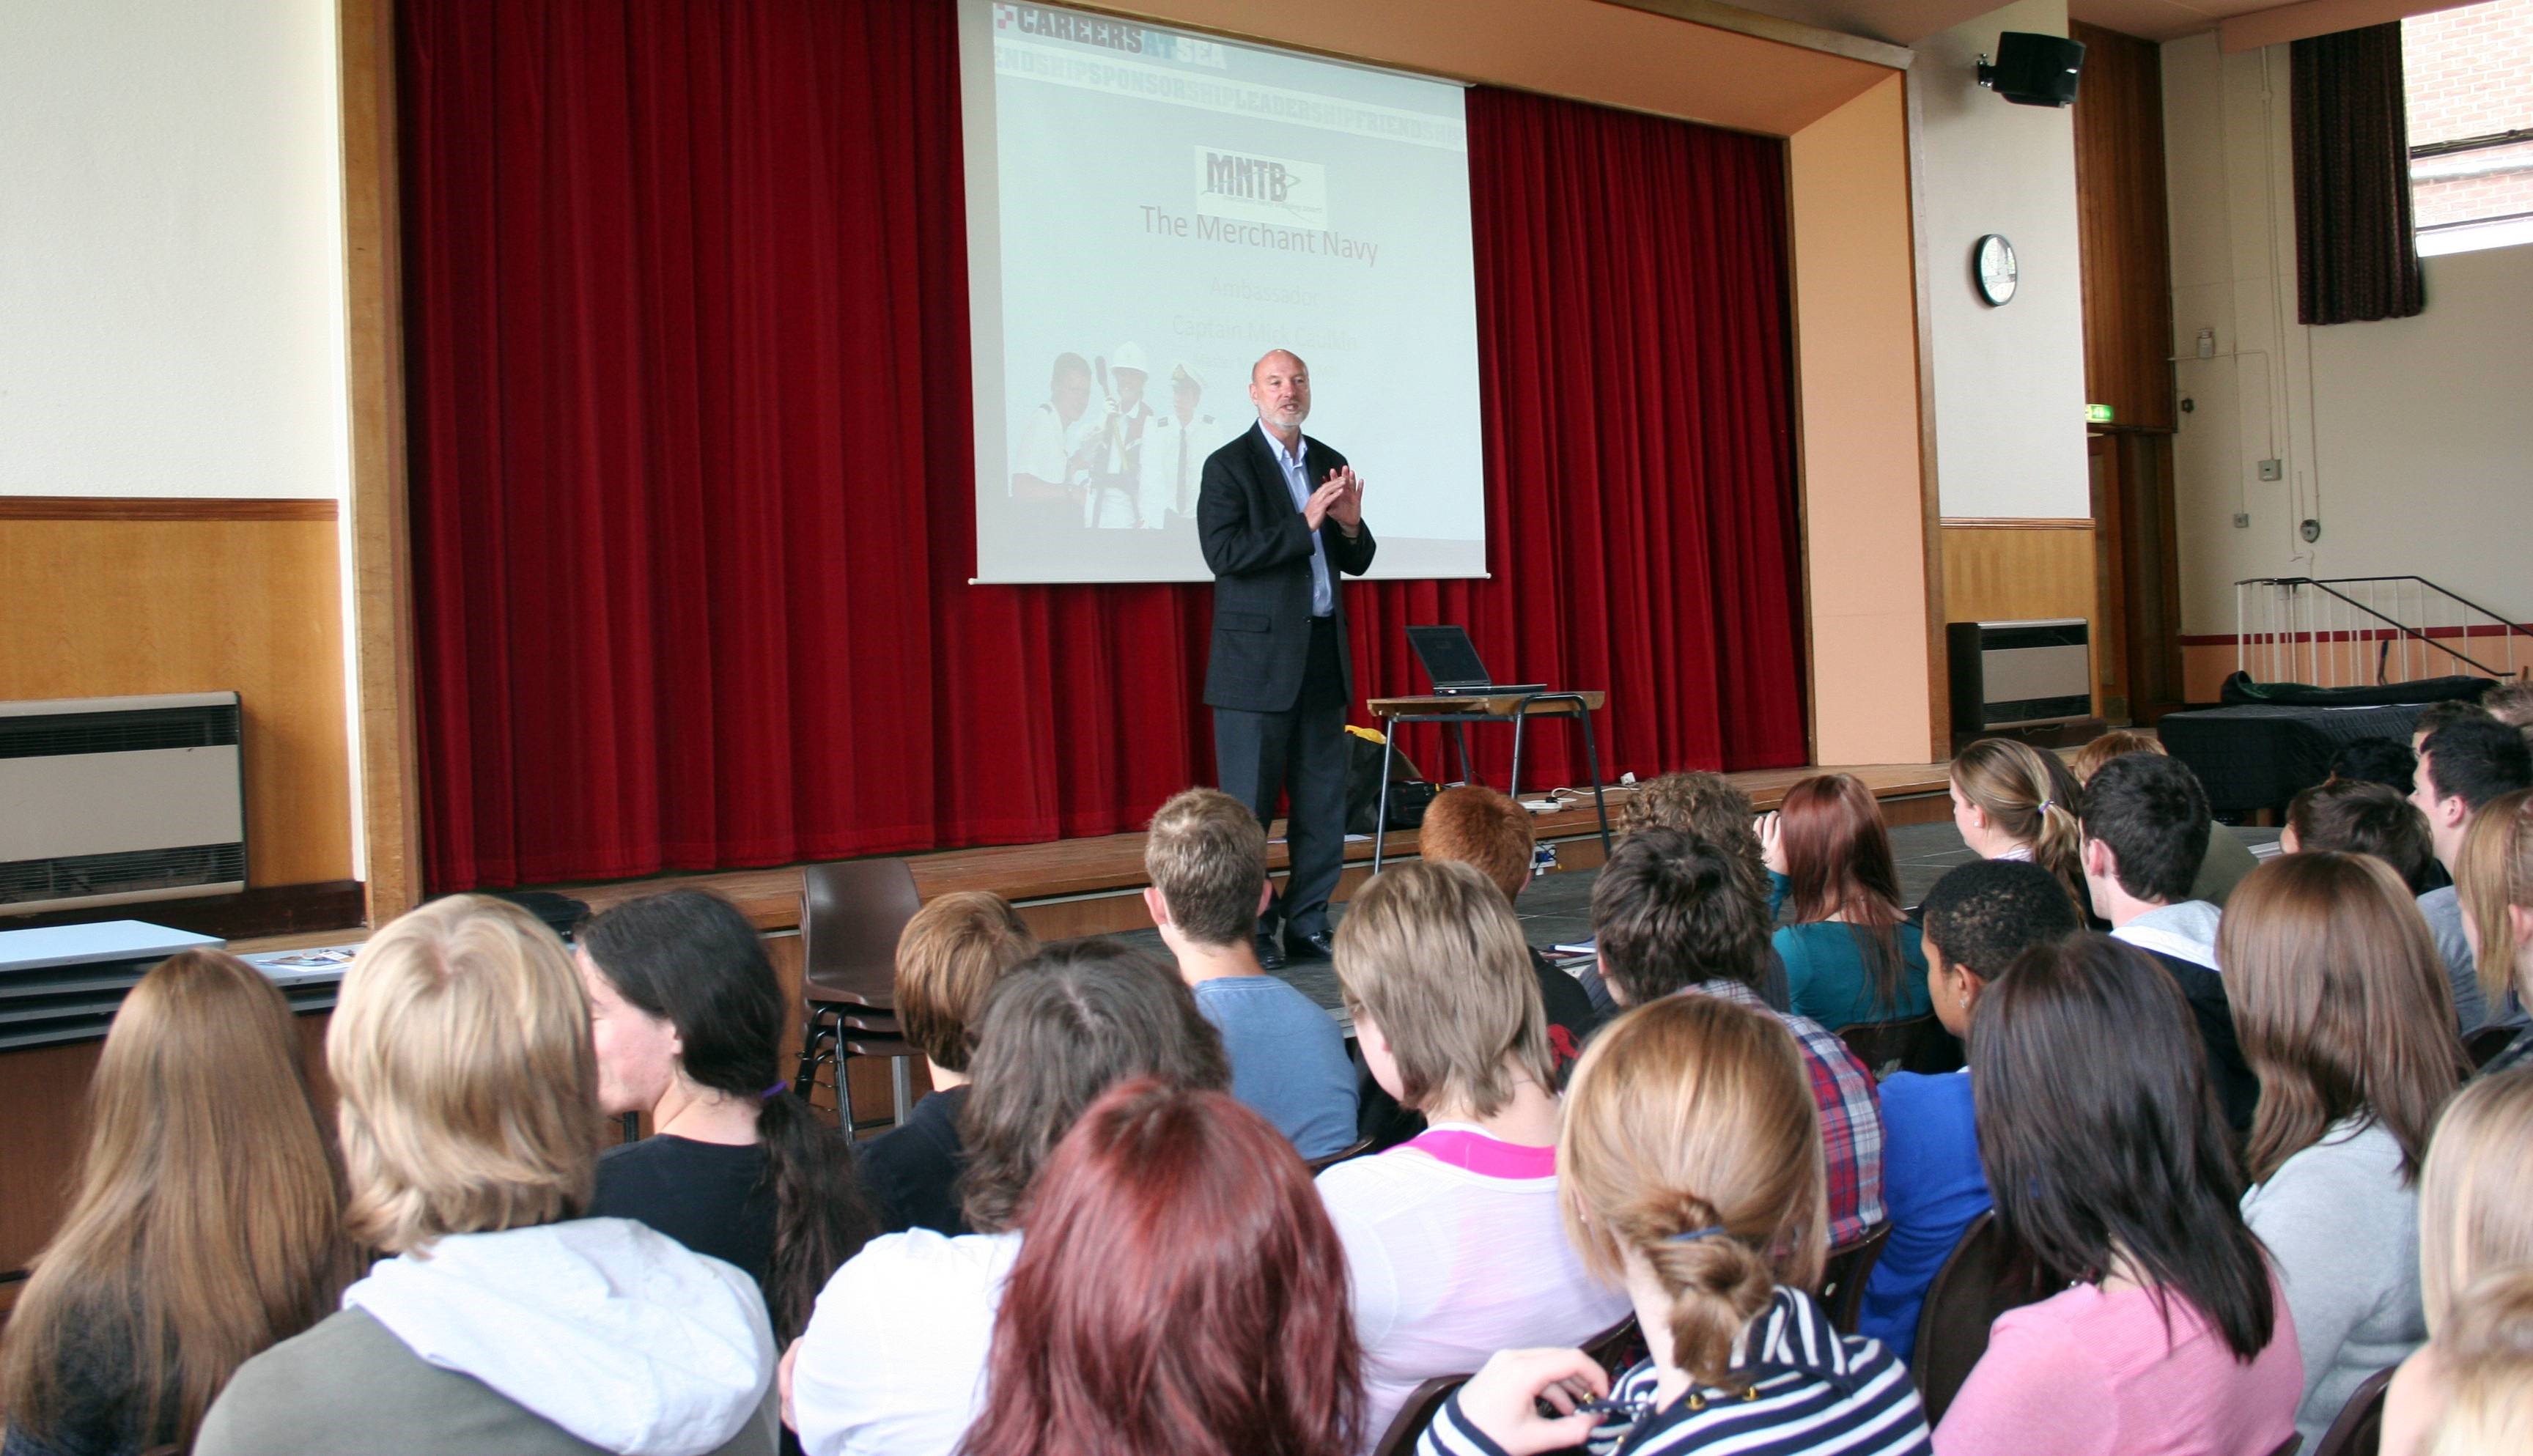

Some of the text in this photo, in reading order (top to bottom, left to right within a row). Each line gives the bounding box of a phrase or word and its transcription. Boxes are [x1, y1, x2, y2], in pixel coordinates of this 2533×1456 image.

[1206, 152, 1288, 202] MNTB
[1140, 204, 1188, 237] The
[1197, 214, 1316, 254] Merchant
[1323, 230, 1378, 267] Navy
[1210, 277, 1319, 307] Ambassador
[1173, 314, 1241, 341] Captain
